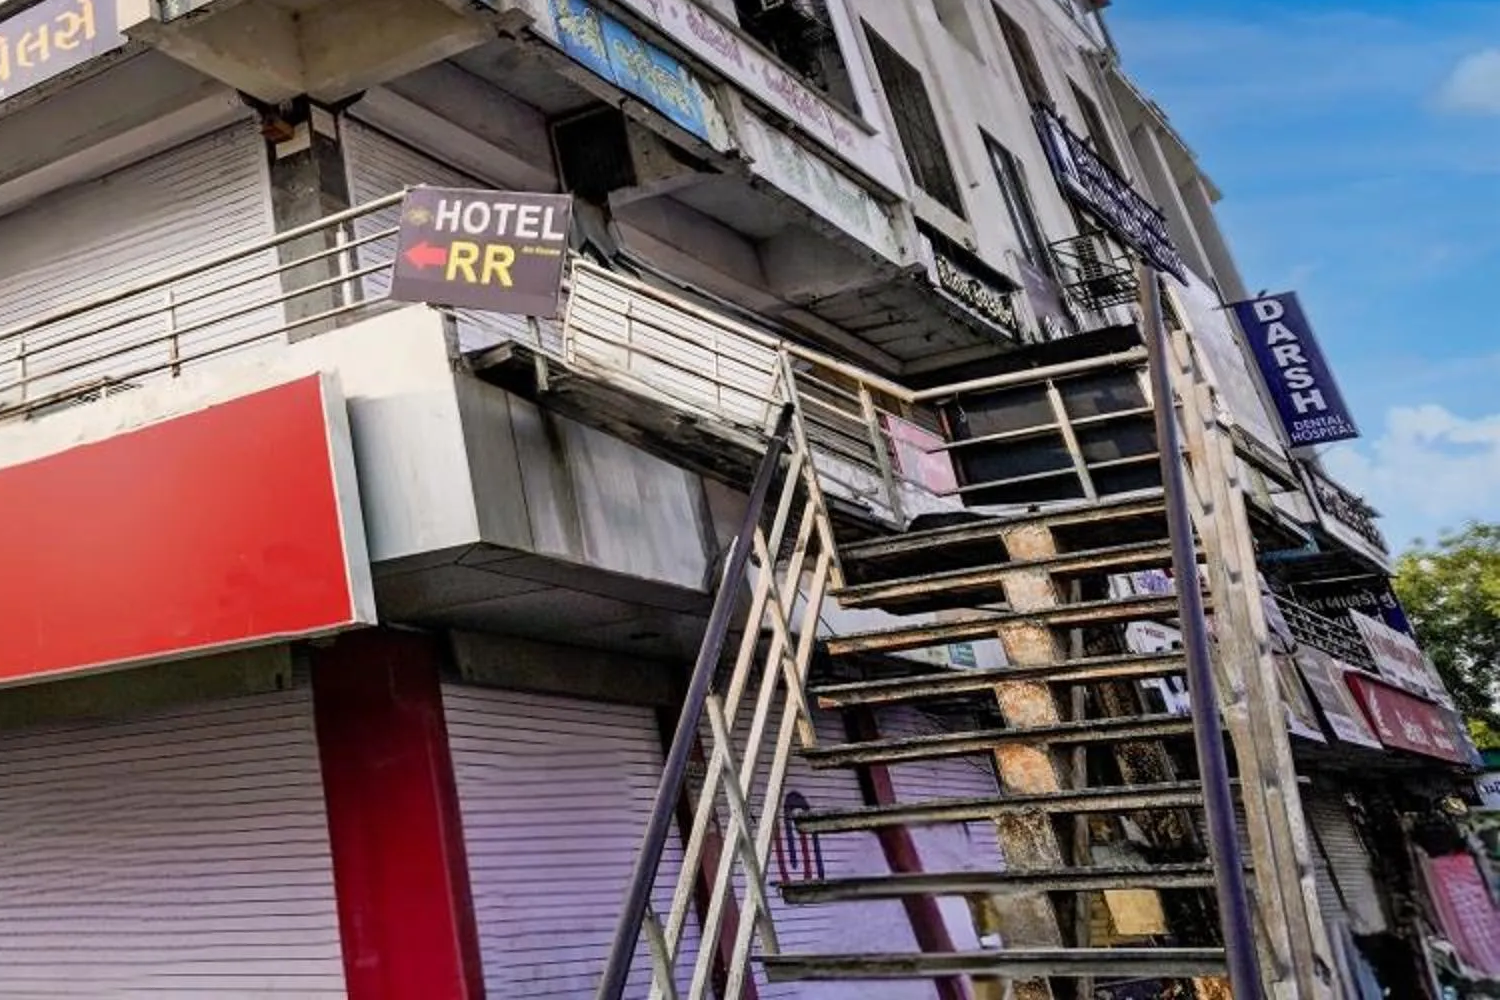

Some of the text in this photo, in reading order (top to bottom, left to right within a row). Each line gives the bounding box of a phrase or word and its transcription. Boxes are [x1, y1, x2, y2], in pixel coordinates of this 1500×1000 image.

[435, 199, 565, 241] HOTEL
[445, 241, 515, 288] RR
[1253, 299, 1328, 414] DARSH
[1291, 424, 1358, 442] HOSPITAL
[1293, 414, 1346, 432] DENTAL
